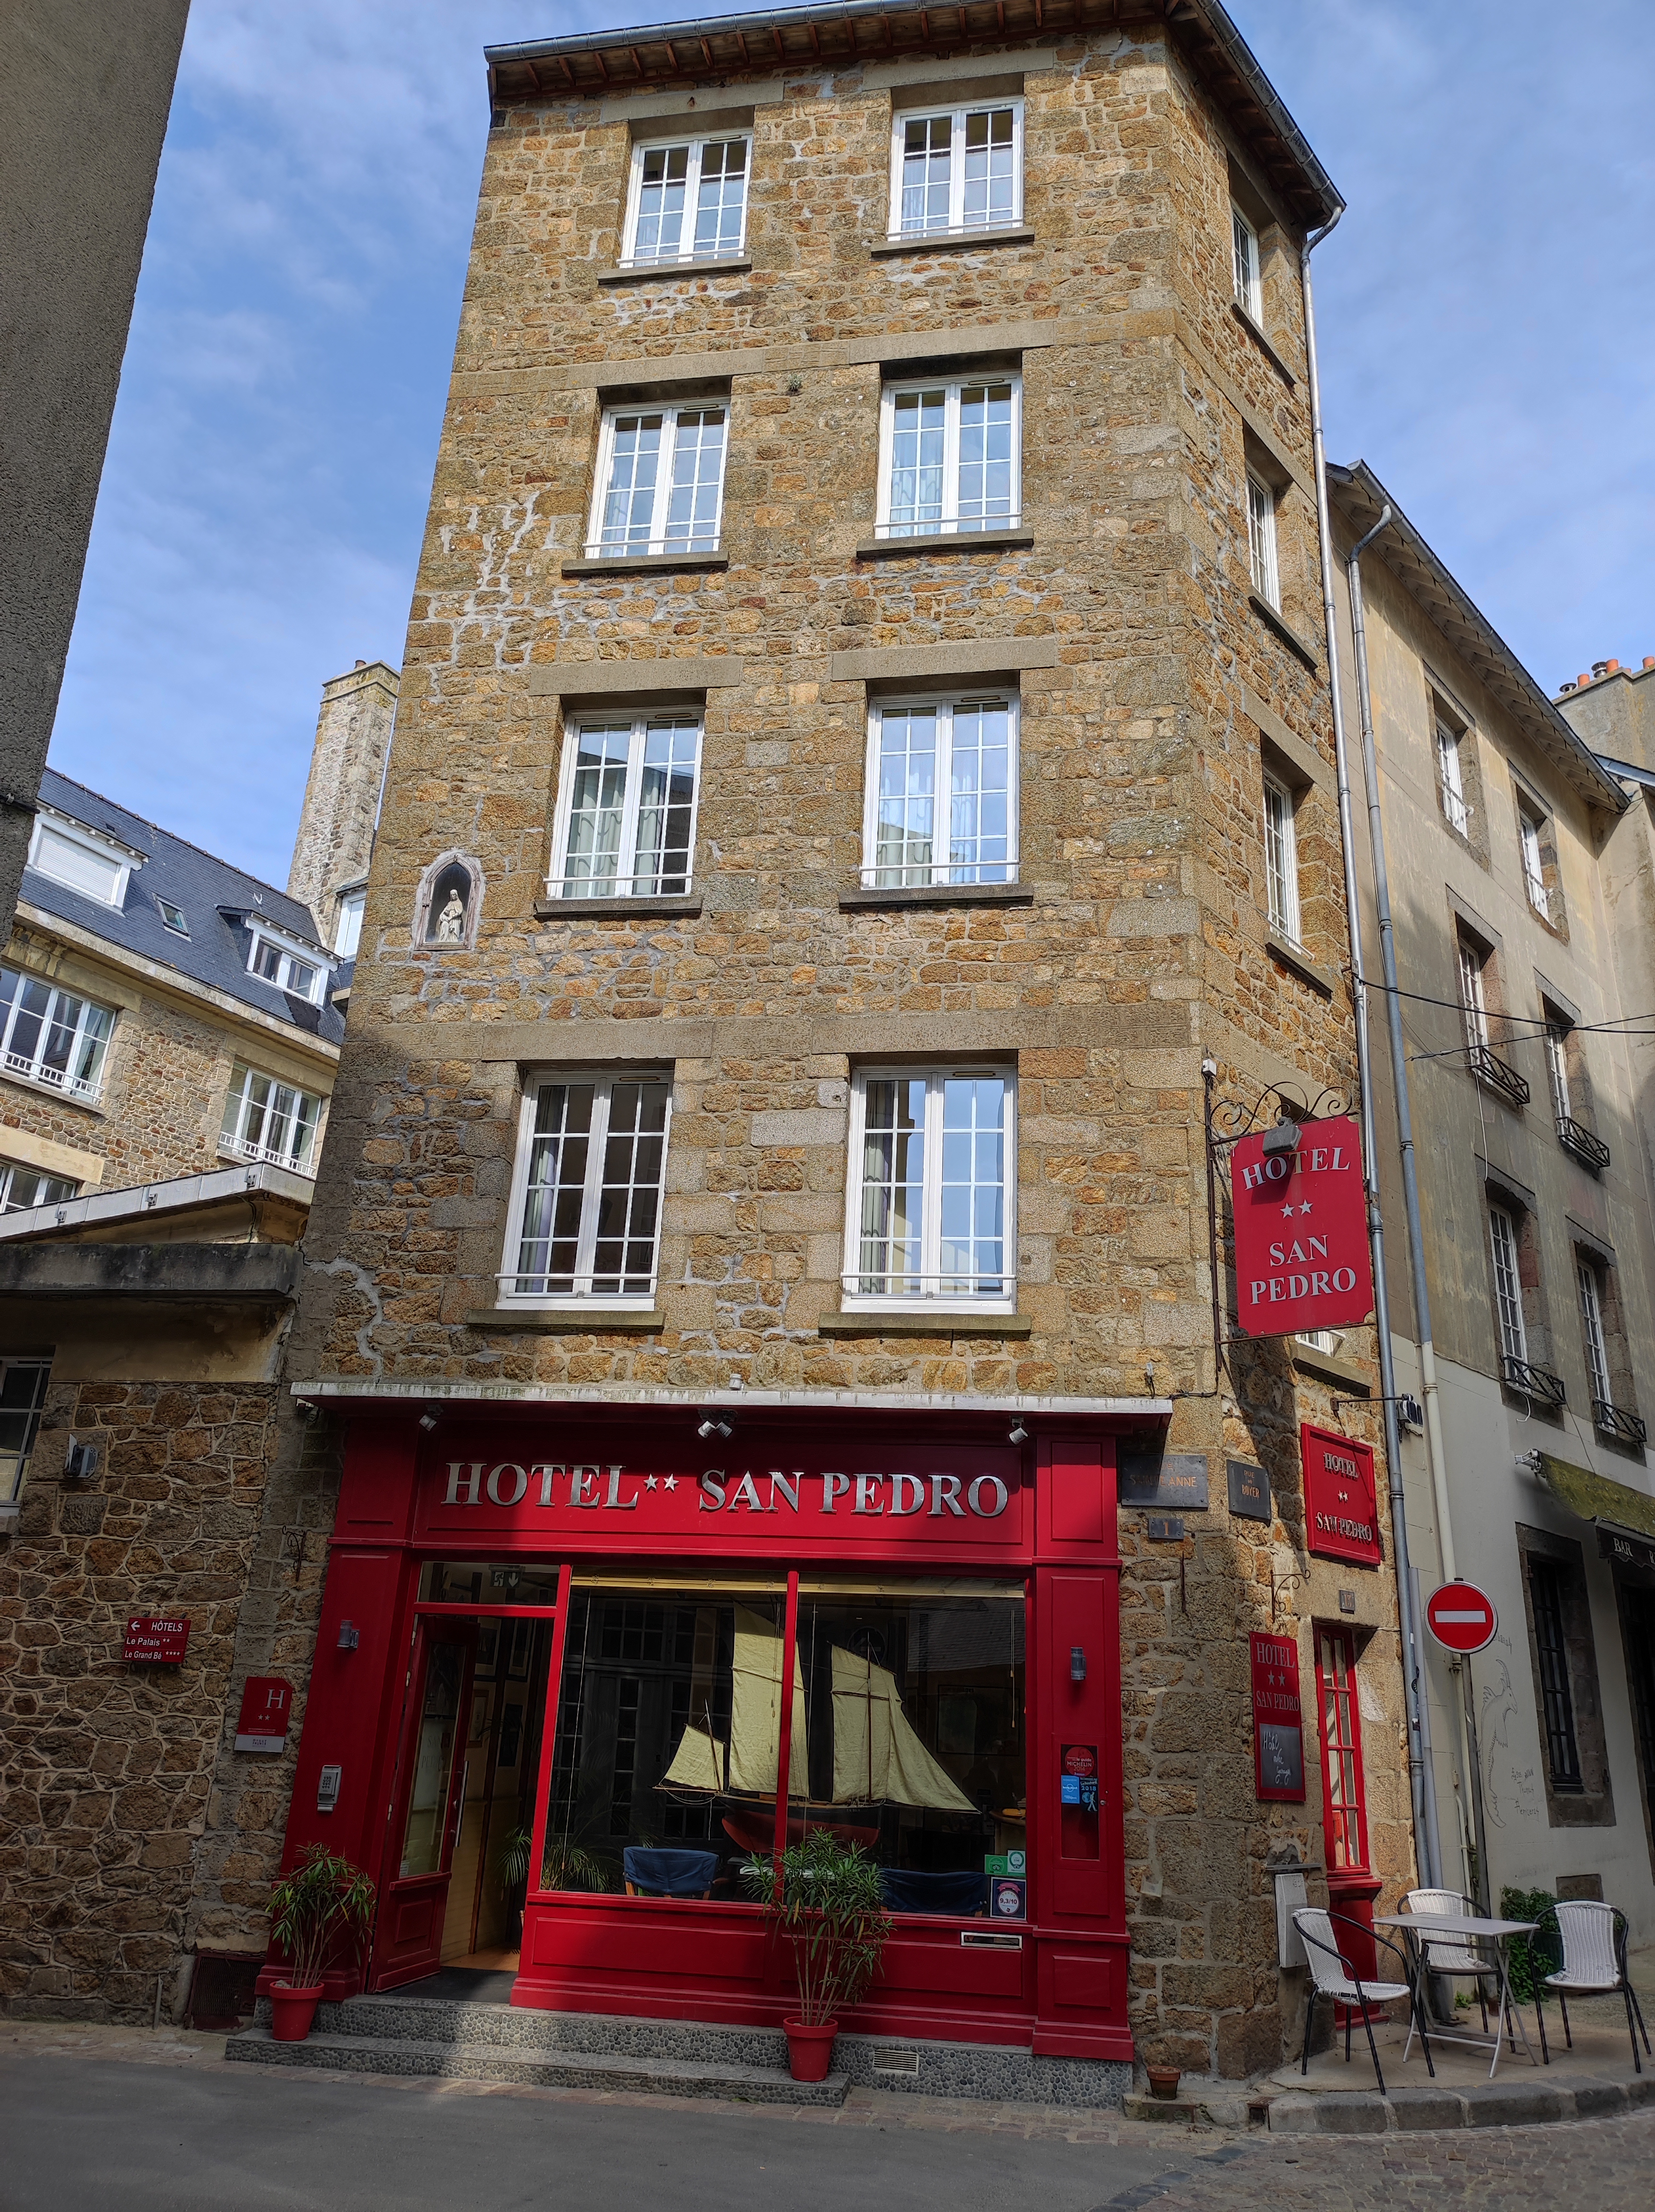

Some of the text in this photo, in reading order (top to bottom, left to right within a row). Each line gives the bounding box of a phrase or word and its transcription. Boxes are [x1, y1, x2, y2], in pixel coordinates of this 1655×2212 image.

[1240, 1147, 1351, 1191] HOTEL
[1269, 1234, 1329, 1267] SAN
[1248, 1267, 1357, 1305] PEDRO
[1244, 1470, 1255, 1478] RUE
[1324, 1452, 1359, 1478] HOTEL
[440, 1463, 1009, 1517] HOTEL SAN PEDRO
[1169, 1475, 1197, 1487] ANNE
[1241, 1484, 1260, 1498] BOYER
[1163, 1520, 1169, 1536] 1
[1316, 1511, 1372, 1542] SAN PEDRO
[1613, 1537, 1634, 1557] BAR
[151, 1620, 183, 1632] HÔTELS
[126, 1637, 160, 1646] Le Palais
[134, 1651, 153, 1659] Grand
[153, 1651, 162, 1659] Bé
[1256, 1642, 1295, 1669] HOTEL
[265, 1689, 286, 1709] H
[1256, 1690, 1299, 1712] SAN PEDRO
[1263, 1731, 1279, 1751] Hôtel
